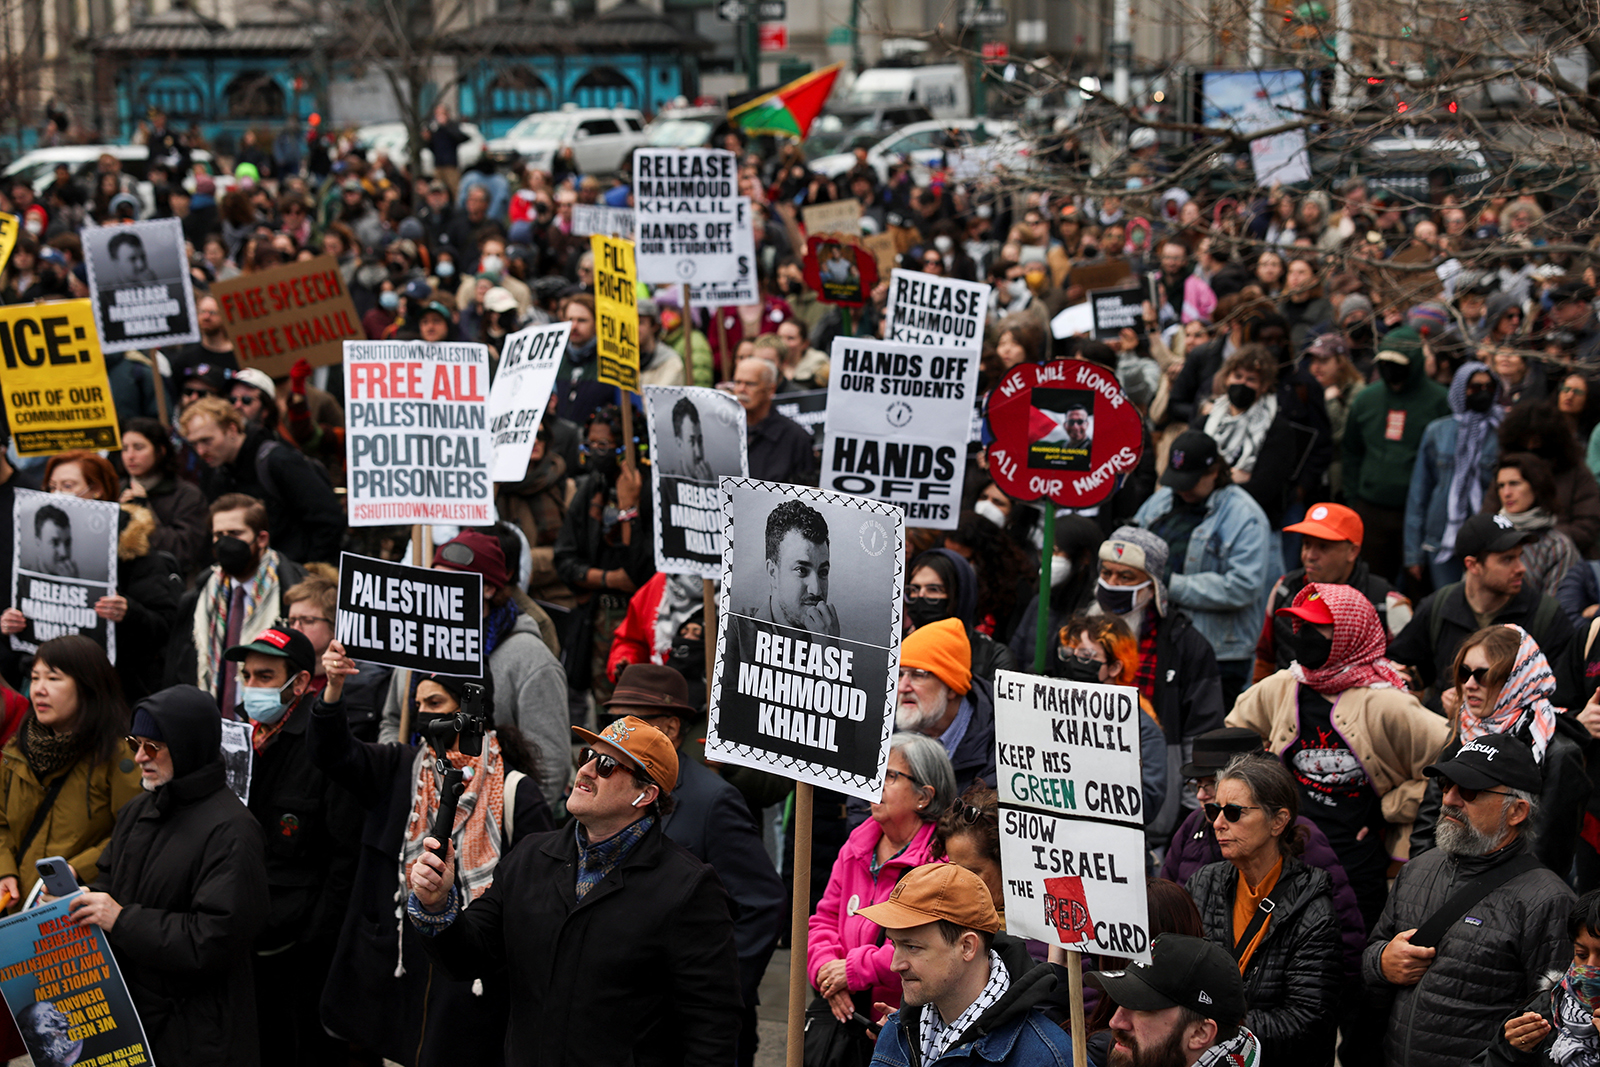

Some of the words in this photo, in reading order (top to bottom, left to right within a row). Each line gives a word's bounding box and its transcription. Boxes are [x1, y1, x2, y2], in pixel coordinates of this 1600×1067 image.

[640, 155, 731, 178] RELEASE
[639, 181, 730, 198] MAHMOUD
[639, 201, 730, 213] KHALIL
[641, 222, 698, 239] HANDS
[705, 222, 732, 239] OFF
[641, 242, 665, 254] OUR
[670, 241, 732, 254] STUDENTS
[221, 286, 269, 325] FREE
[267, 269, 342, 312] SPEECH
[897, 277, 981, 317] RELEASE
[236, 326, 284, 361] FREE
[282, 309, 357, 351] KHALIL
[892, 305, 976, 339] MAHMOUD
[0, 316, 91, 369] ICE:
[350, 344, 483, 363] #SHUTITDOWN4PALESTINE
[527, 330, 565, 361] OFF
[842, 348, 922, 378] HANDS
[930, 356, 968, 380] OFF
[12, 390, 41, 407] OUT
[45, 388, 64, 406] OF
[69, 386, 104, 404] OUR
[351, 363, 424, 399] FREE
[432, 365, 485, 402] ALL
[840, 374, 875, 394] OUR
[880, 378, 965, 400] STUDENTS
[1000, 371, 1026, 398] WE
[1035, 361, 1066, 384] WILL
[1075, 365, 1125, 410] HONOR
[15, 406, 106, 425] COMMUNITIES!
[350, 402, 485, 430] PALESTINIAN
[352, 434, 486, 468] POLITICAL
[832, 436, 956, 481] HANDS
[353, 469, 488, 499] PRISONERS
[991, 449, 1019, 482] ALL
[1029, 475, 1064, 497] OUR
[1072, 446, 1137, 497] MARTYRS
[676, 482, 722, 510] RELEAS
[832, 475, 951, 501] OFF
[354, 502, 488, 520] #SHUTITDOWN4PALESTINE
[29, 578, 89, 608] RELEASE
[350, 570, 464, 622] PALESTINE
[21, 597, 98, 629] MAHMOUD
[337, 609, 384, 650] WILL
[389, 618, 418, 656] BE
[423, 623, 480, 662] FREE
[755, 630, 854, 684] RELEASE
[737, 662, 868, 723] MAHMOUD
[997, 675, 1026, 702] LET
[1033, 683, 1132, 723] MAHMOUD
[757, 702, 840, 753] KHALIL
[1052, 718, 1132, 753] KHALIL
[998, 742, 1036, 771] KEEP
[1042, 750, 1072, 774] HIS
[1011, 772, 1077, 810] GREEN
[1085, 780, 1142, 817] CARD
[1005, 811, 1057, 844] SHOW
[1032, 845, 1128, 884] ISRAEL
[1008, 879, 1035, 899] THE
[1043, 893, 1088, 933] RED
[1094, 921, 1148, 955] CARD
[33, 924, 93, 955] DIFFERENT
[88, 937, 99, 950] A
[0, 942, 90, 983] FUNDAMENTALLY
[33, 964, 63, 985] LIVE,
[62, 959, 79, 975] TO
[79, 951, 106, 970] WAY
[101, 964, 111, 979] A
[34, 980, 62, 1002] NEW
[63, 969, 102, 993] WHOLE
[66, 1010, 87, 1027] WE
[88, 1001, 111, 1021] AND
[99, 1015, 118, 1031] WE
[67, 1021, 98, 1042] NEED
[97, 1052, 113, 1066] AND
[113, 1043, 143, 1060] ROTTEN
[127, 1053, 147, 1067] THIS
